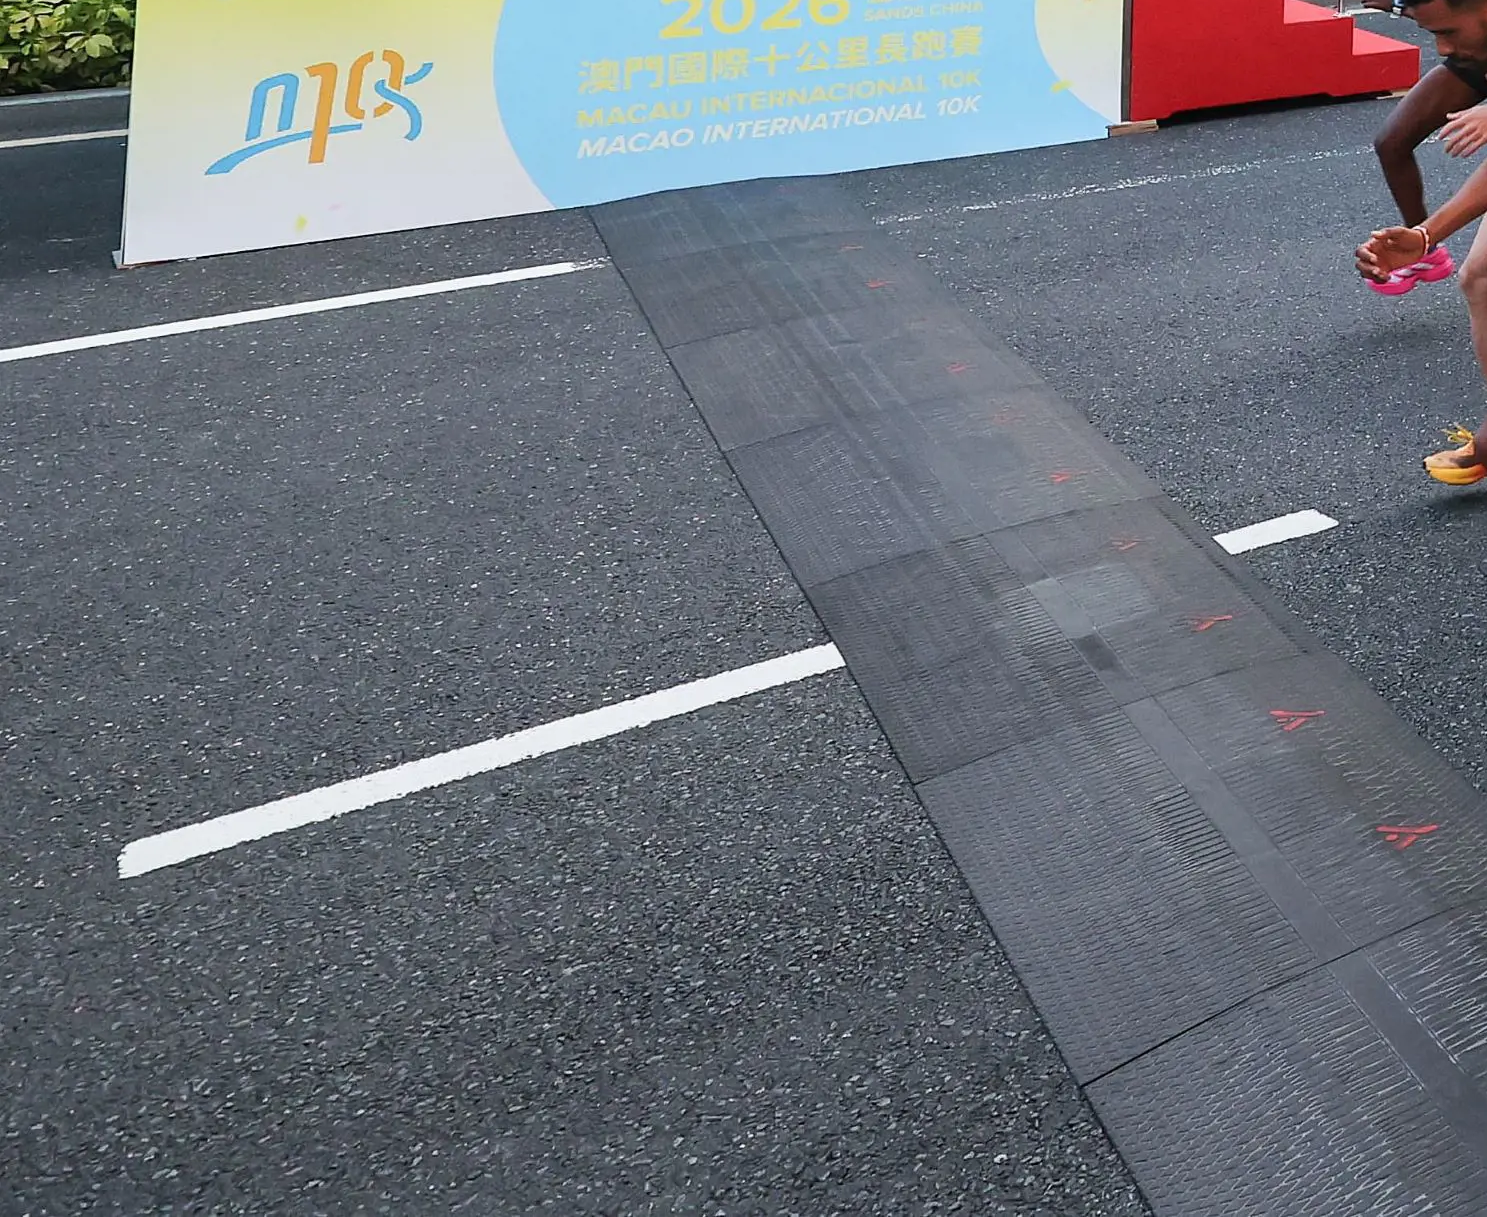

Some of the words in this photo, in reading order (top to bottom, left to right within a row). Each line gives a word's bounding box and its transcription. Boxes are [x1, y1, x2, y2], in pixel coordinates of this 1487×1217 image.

[864, 5, 925, 23] SANDS
[929, 0, 984, 18] CHINA
[576, 25, 983, 96] 澳門國際十公里長跑賽
[576, 99, 693, 129] MACAU
[701, 77, 929, 117] INTERNACIONAL
[937, 68, 982, 89] 10K
[576, 127, 695, 160] MACAO
[701, 102, 926, 146] INTERNATIONAL
[935, 94, 982, 117] 10K
